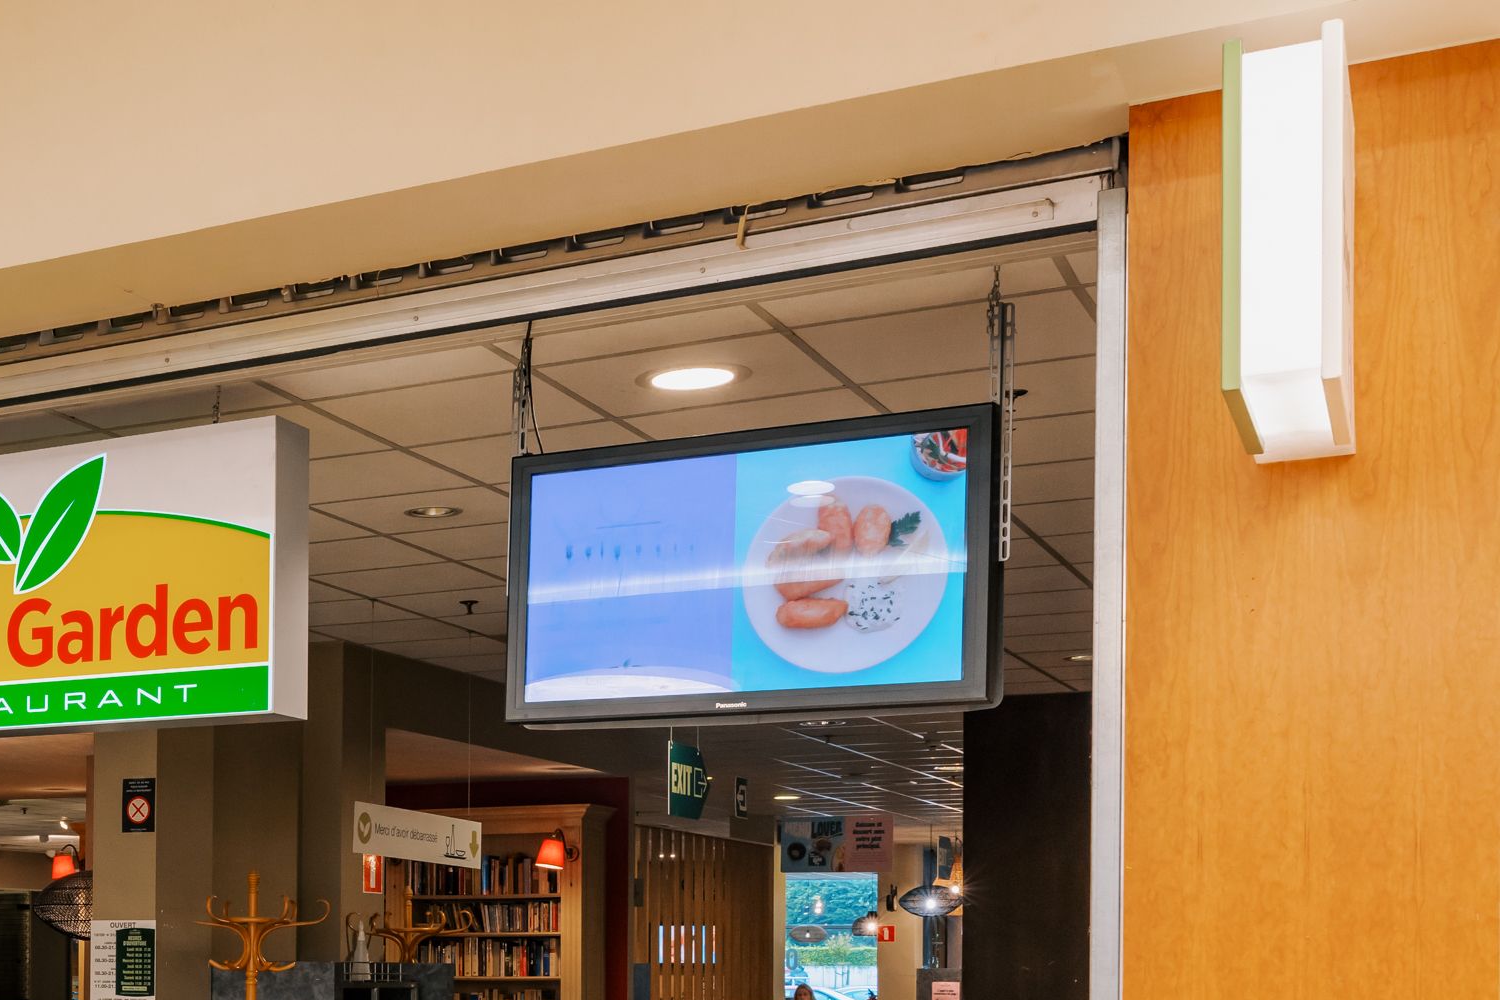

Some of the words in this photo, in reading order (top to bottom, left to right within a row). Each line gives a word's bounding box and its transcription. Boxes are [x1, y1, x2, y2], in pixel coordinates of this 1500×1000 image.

[7, 584, 258, 668] Garden
[715, 701, 748, 709] Panasonic
[671, 762, 693, 797] EXIT
[374, 822, 390, 836] Merci
[811, 820, 843, 838] LOVER
